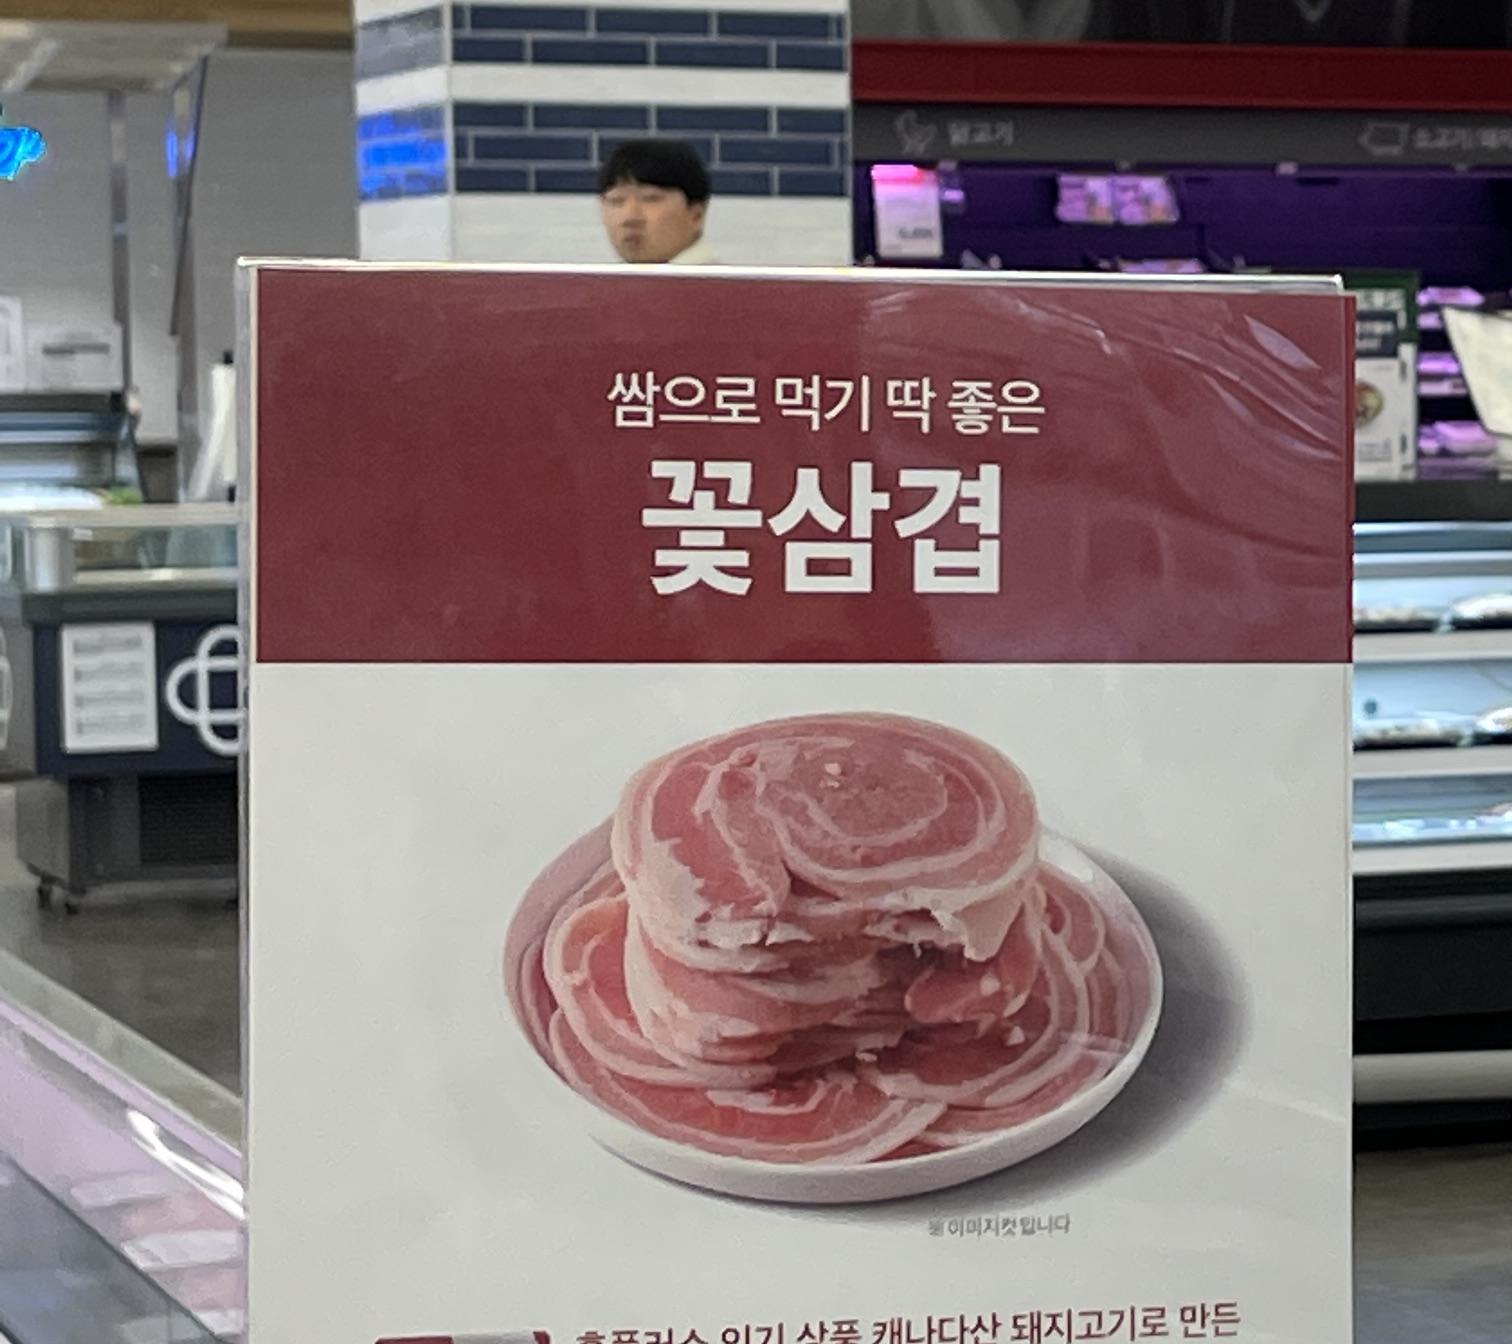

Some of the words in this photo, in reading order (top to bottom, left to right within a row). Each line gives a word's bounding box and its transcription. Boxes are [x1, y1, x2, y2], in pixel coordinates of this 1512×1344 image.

[606, 370, 761, 429] 쌈으로
[774, 374, 870, 432] 먹기
[886, 376, 937, 434] 딱
[947, 380, 1046, 436] 좋은
[641, 460, 1001, 596] 꽃삼겹
[1179, 1301, 1241, 1338] 만든
